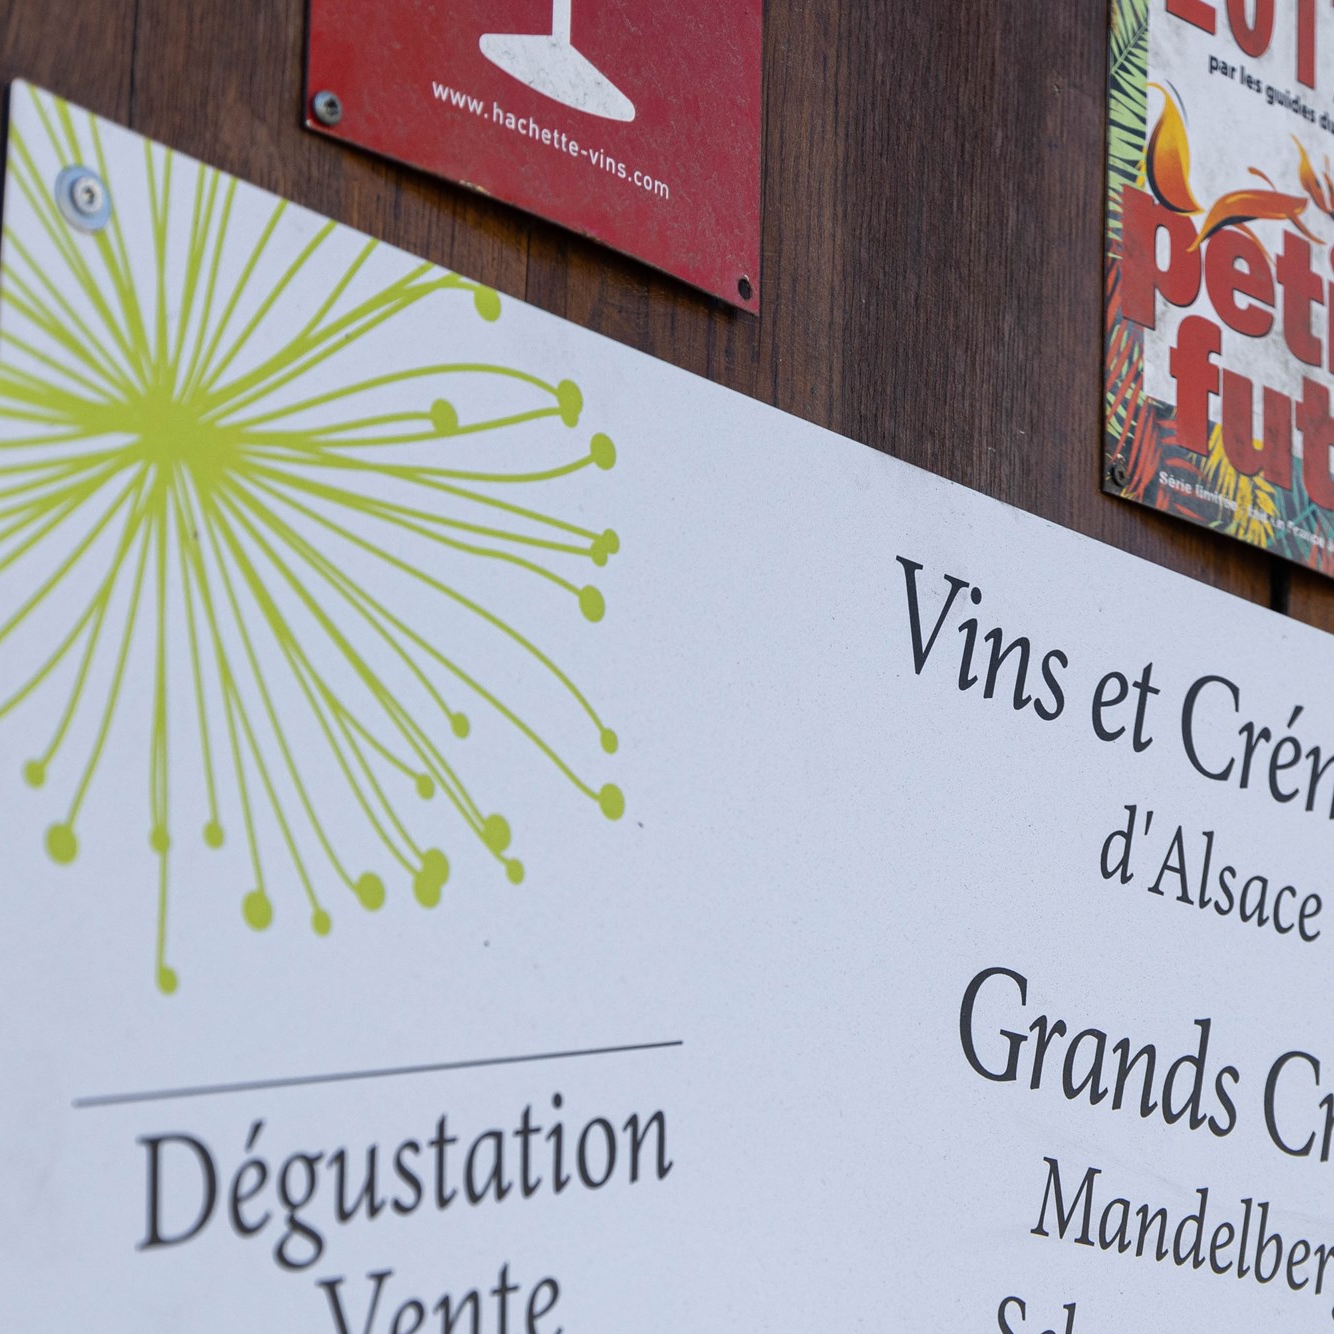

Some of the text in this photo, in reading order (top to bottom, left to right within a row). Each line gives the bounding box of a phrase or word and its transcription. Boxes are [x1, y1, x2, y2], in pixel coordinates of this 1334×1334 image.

[432, 80, 670, 199] www.hachette-vins.com
[1208, 54, 1237, 80] par
[1240, 64, 1263, 94] les
[1265, 84, 1316, 123] guides
[1158, 470, 1193, 495] Série
[895, 554, 1069, 721] Vins
[1092, 661, 1161, 753] et
[1100, 804, 1323, 942] d'Alsace
[959, 966, 1240, 1137] Grands
[136, 1092, 675, 1272] Dégustation
